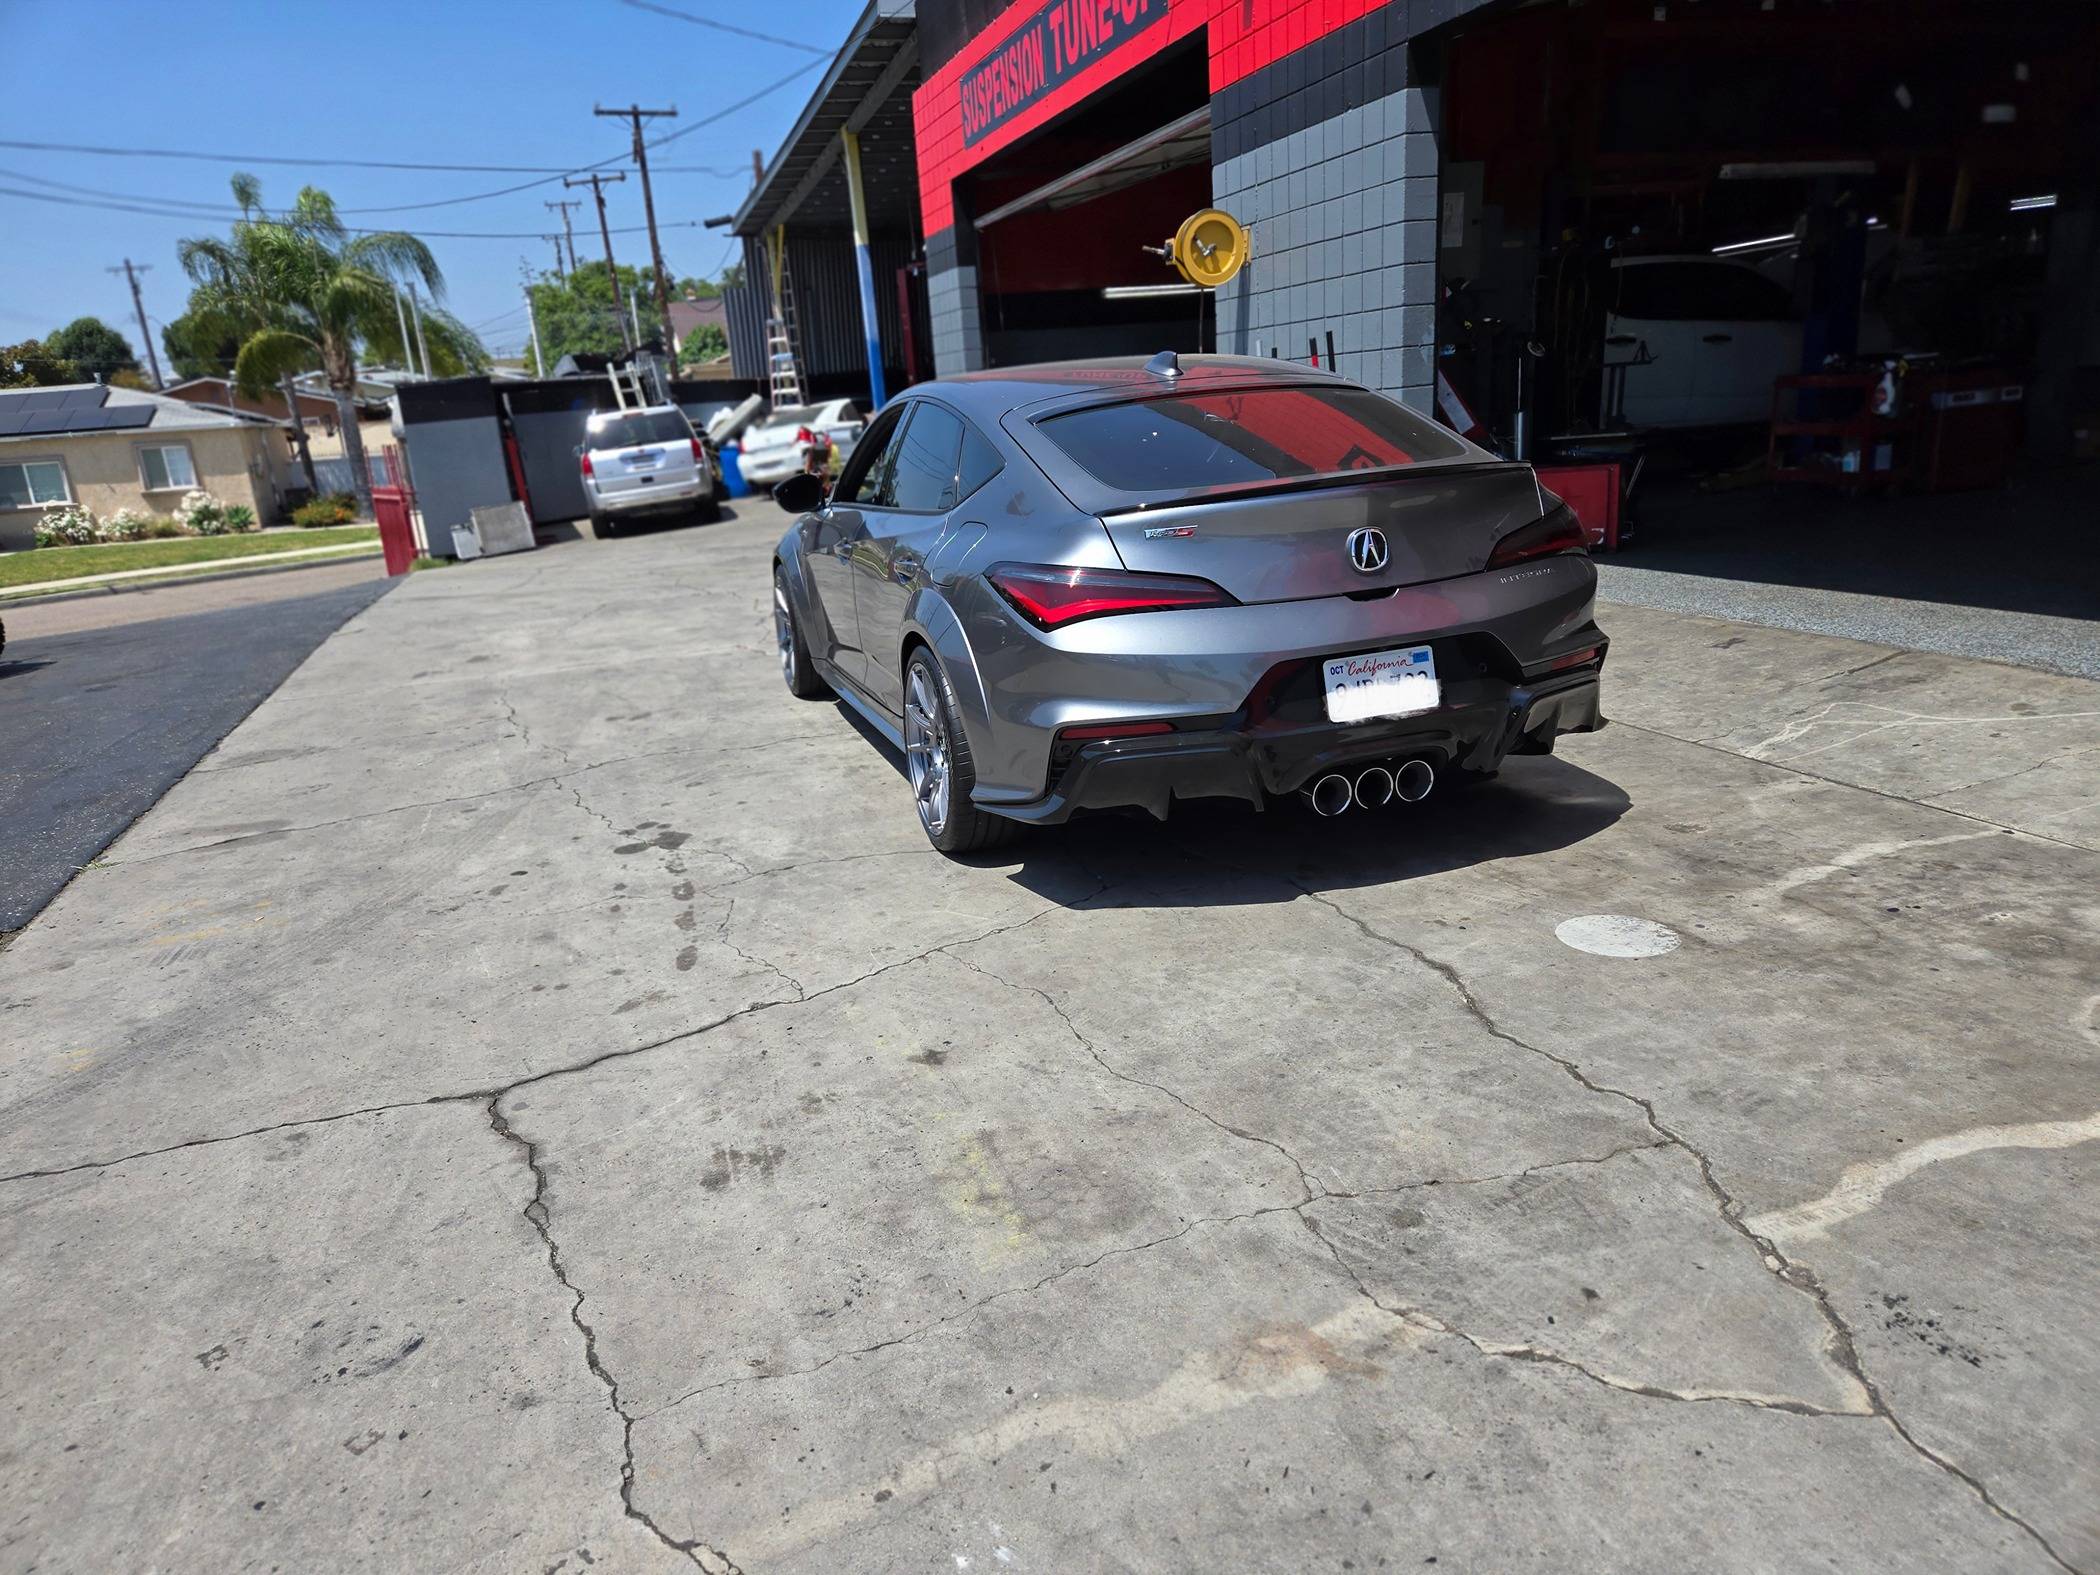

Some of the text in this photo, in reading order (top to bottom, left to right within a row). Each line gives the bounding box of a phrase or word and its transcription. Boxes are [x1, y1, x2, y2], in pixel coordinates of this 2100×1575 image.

[962, 0, 1148, 138] SUSPENSION TUNE-
[1330, 664, 1345, 676] OCT
[1347, 656, 1414, 677] California
